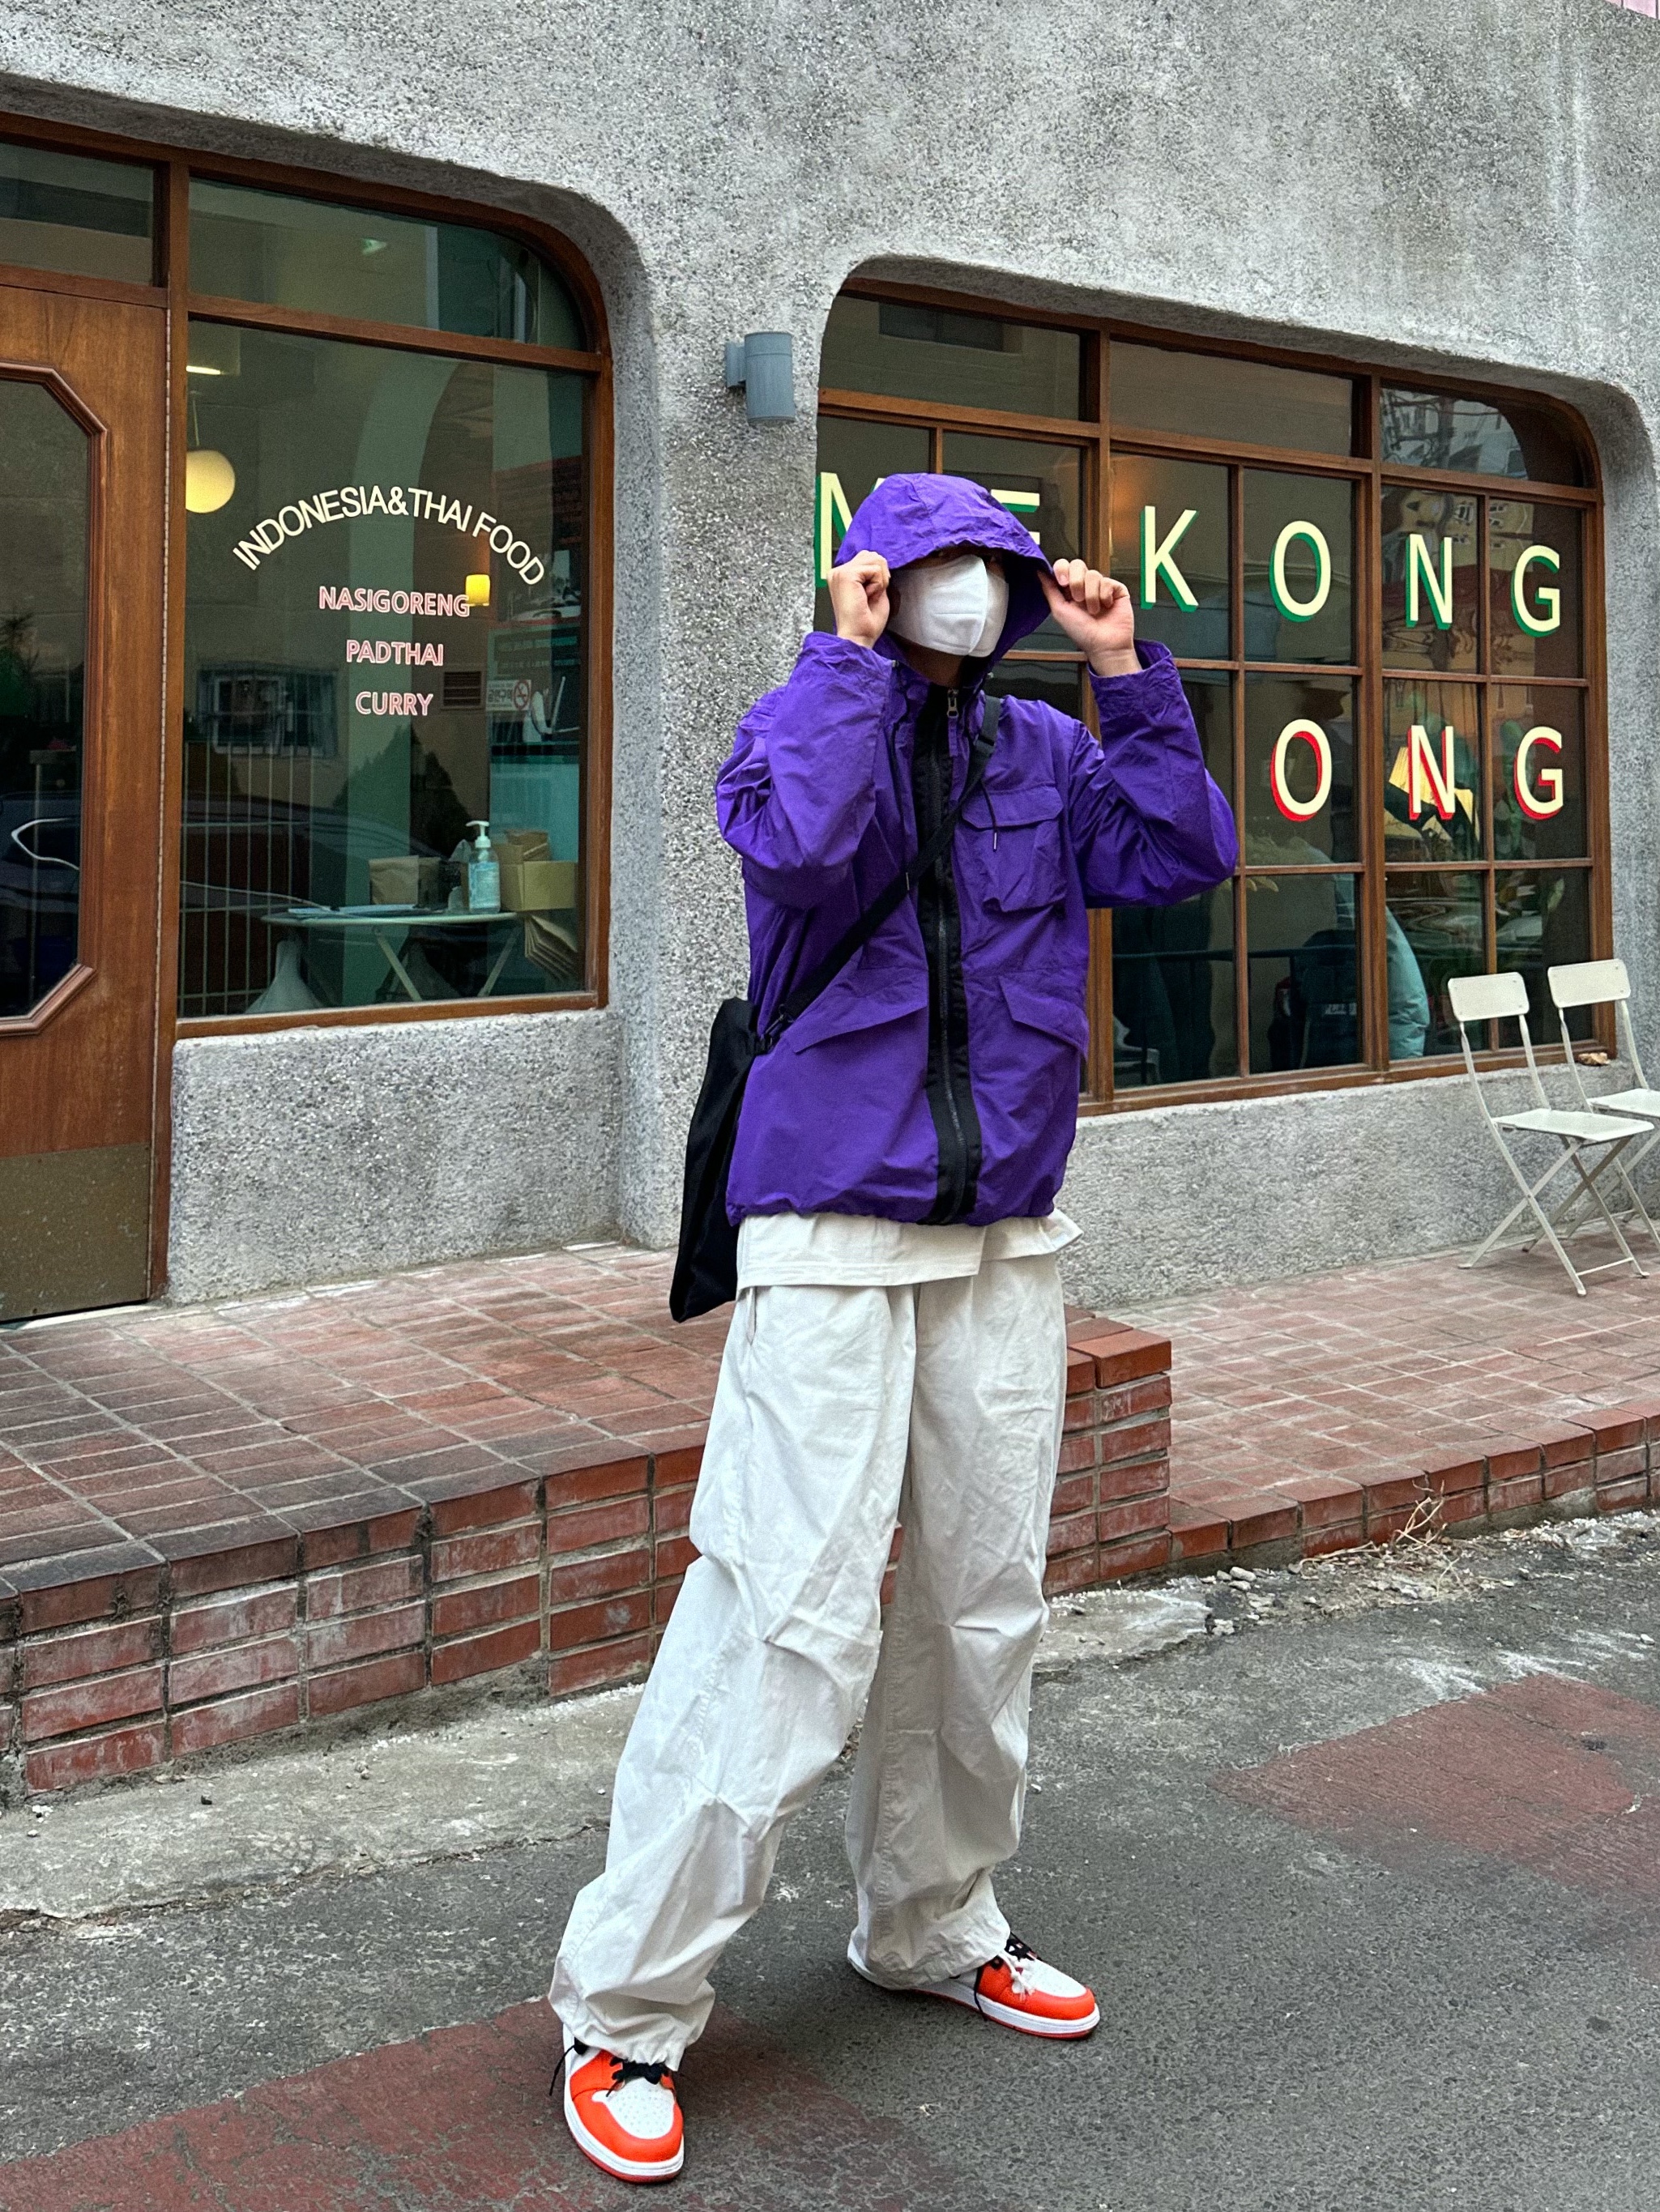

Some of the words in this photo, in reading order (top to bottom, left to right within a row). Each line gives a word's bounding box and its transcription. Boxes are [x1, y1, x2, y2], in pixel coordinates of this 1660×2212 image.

[233, 485, 473, 570] INDONESIA&THAI
[472, 512, 545, 586] FOOD
[318, 586, 471, 617] NASIGORENG
[346, 640, 444, 667] PADTHAI
[355, 691, 434, 717] CURRY
